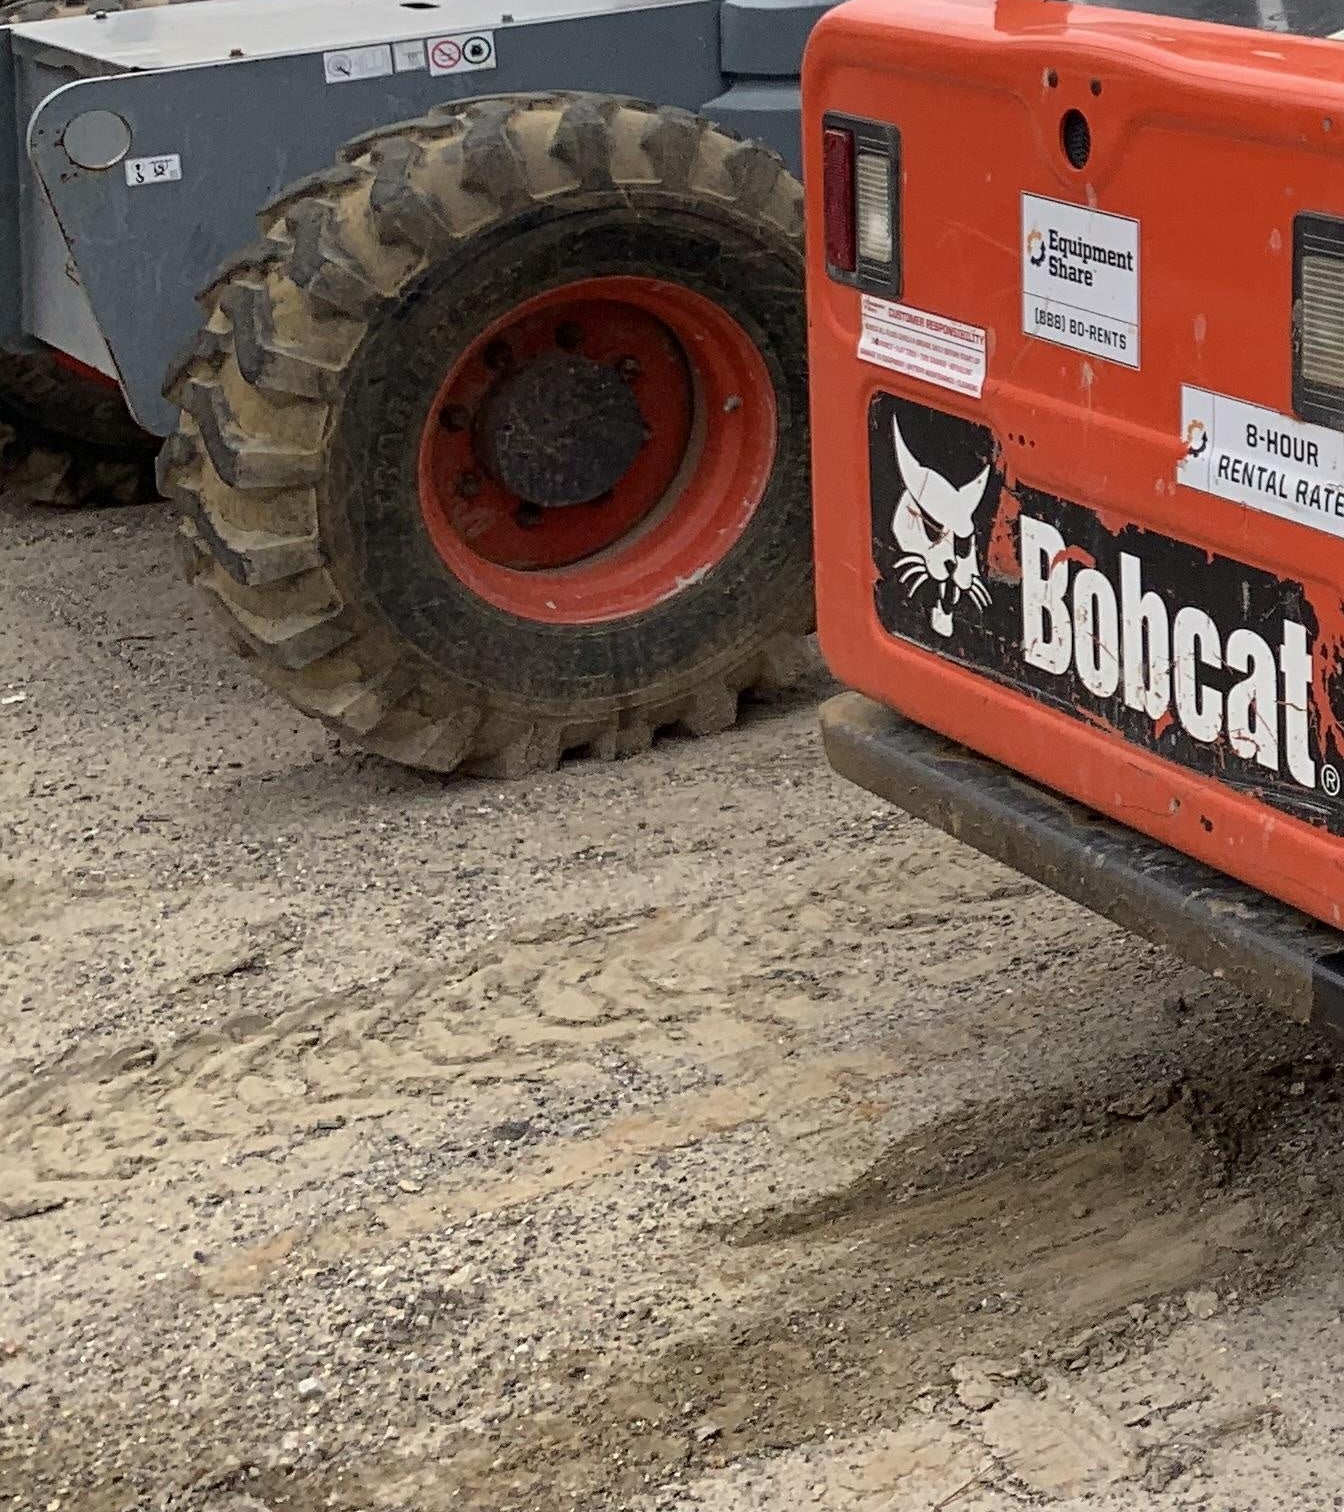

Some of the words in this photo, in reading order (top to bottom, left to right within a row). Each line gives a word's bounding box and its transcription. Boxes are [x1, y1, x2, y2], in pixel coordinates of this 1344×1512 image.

[1048, 229, 1134, 272] Equipment
[1049, 256, 1093, 287] Share
[888, 307, 925, 328] CUSTOMER
[1035, 307, 1066, 333] (888)
[1246, 423, 1319, 467] 8-HOUR
[1217, 454, 1289, 499] RENTAL
[1019, 514, 1316, 788] Bobcat
